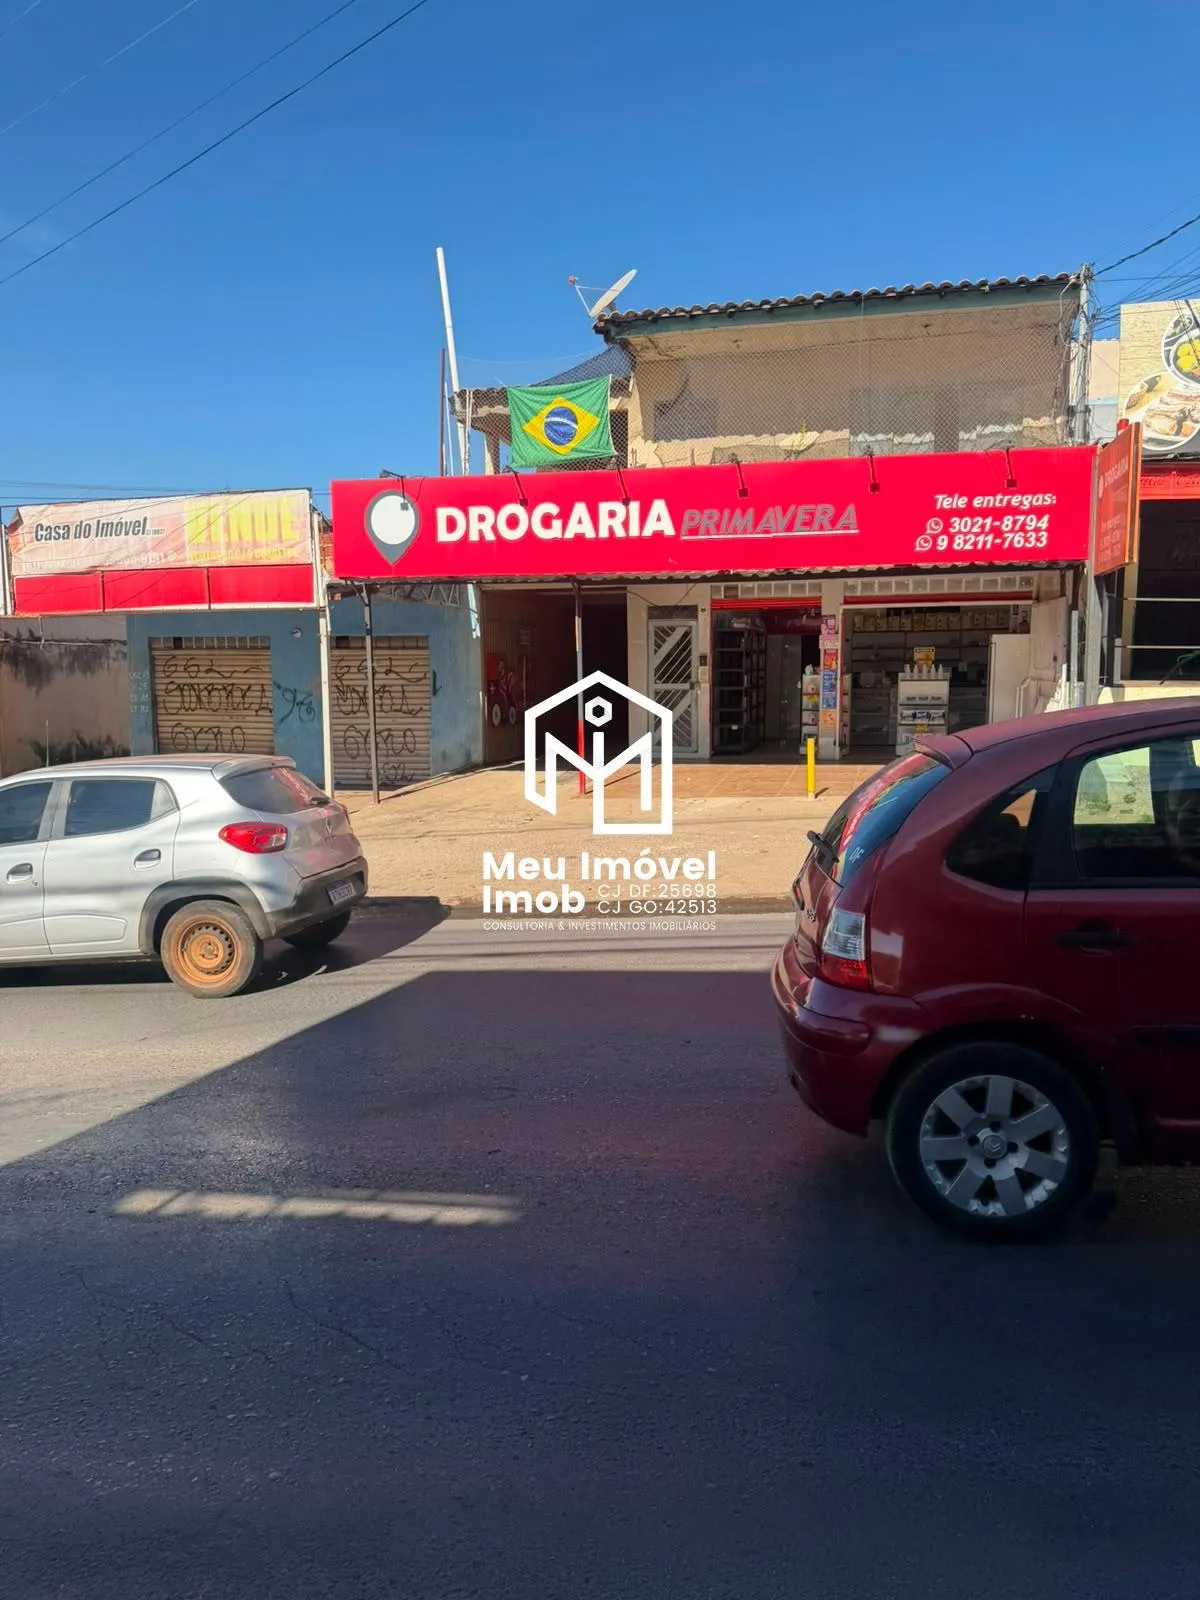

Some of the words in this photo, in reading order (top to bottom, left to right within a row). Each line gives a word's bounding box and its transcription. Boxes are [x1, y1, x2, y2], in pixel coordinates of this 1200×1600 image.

[935, 493, 967, 510] Tele
[972, 493, 1057, 510] entregas:
[34, 523, 71, 542] Casa
[74, 520, 92, 539] do
[95, 516, 148, 538] Imóvel
[435, 499, 676, 543] DROGARIA
[681, 503, 859, 536] PRIMAVERA
[948, 514, 1050, 533] 3021-8794
[936, 535, 948, 550] 9
[953, 531, 1048, 551] 8211-7633
